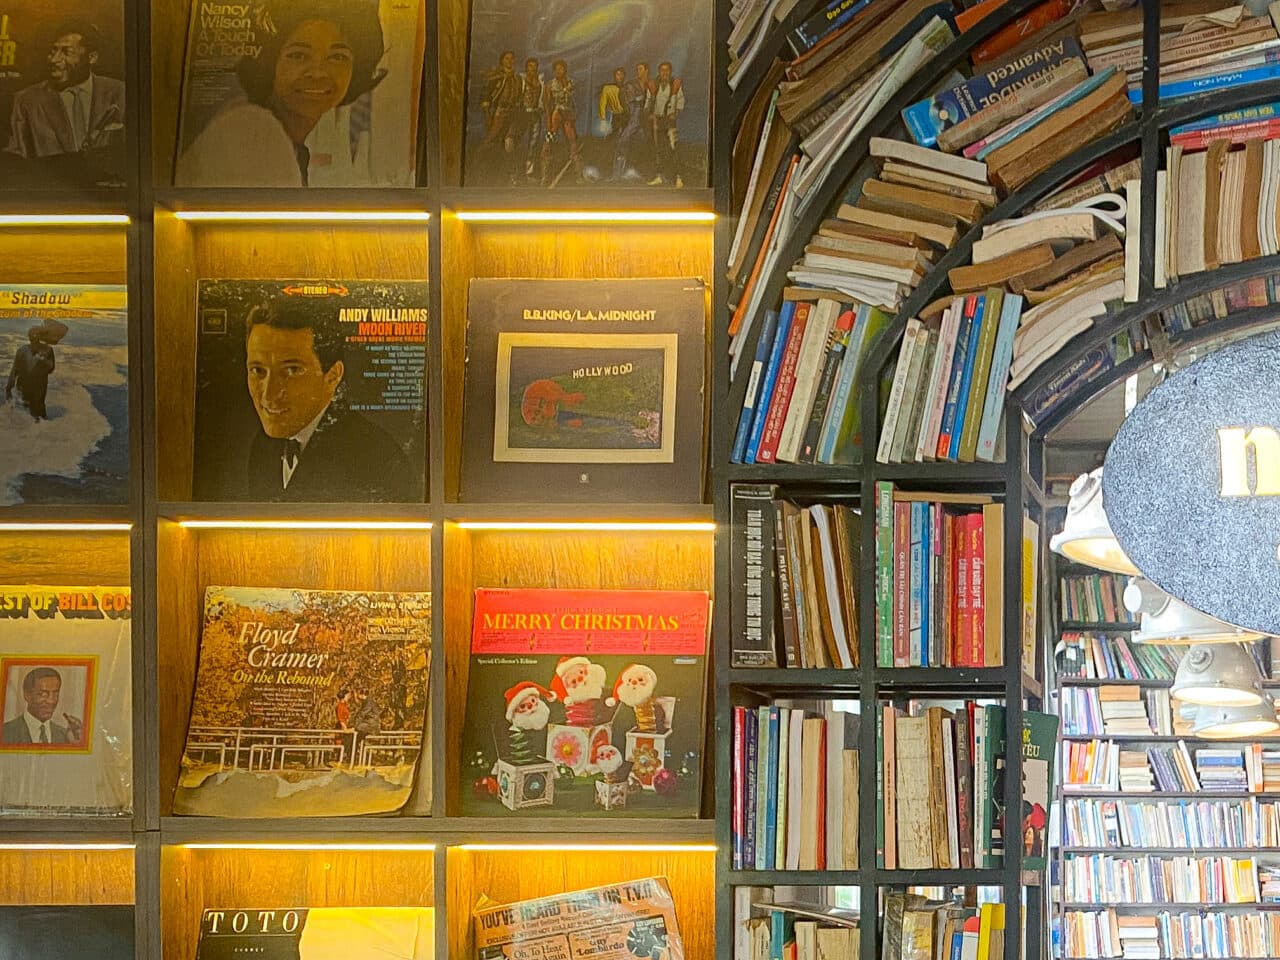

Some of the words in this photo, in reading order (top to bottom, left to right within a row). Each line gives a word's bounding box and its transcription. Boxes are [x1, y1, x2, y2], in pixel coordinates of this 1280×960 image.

[201, 2, 250, 17] Nancy
[201, 15, 251, 29] Wilson
[215, 29, 255, 41] Touch
[216, 42, 263, 59] Today
[986, 39, 1065, 88] Advanced
[979, 57, 1080, 109] BRIDGE
[1193, 76, 1215, 88] NON
[339, 308, 368, 322] ANDY
[370, 308, 428, 322] WILLIAMS
[358, 322, 392, 336] MOON
[394, 322, 426, 336] RIVER
[572, 362, 633, 379] HOLLYWOOD
[881, 490, 890, 528] LONGMAN
[30, 593, 56, 611] OF
[59, 592, 99, 611] BILL
[370, 601, 396, 609] LIVING
[483, 613, 558, 630] MERRY
[559, 614, 680, 631] CHRISTMAS
[238, 621, 301, 649] Floyd
[247, 644, 329, 669] Cramer
[232, 670, 251, 683] On
[254, 671, 273, 684] the
[276, 671, 335, 686] Rebound
[480, 907, 515, 930] YOU'VE
[602, 888, 622, 905] ON
[207, 911, 299, 933] TOTO
[513, 949, 530, 959] Oh,
[530, 947, 541, 957] To
[541, 944, 563, 956] Hear
[576, 941, 625, 957] Lombardo
